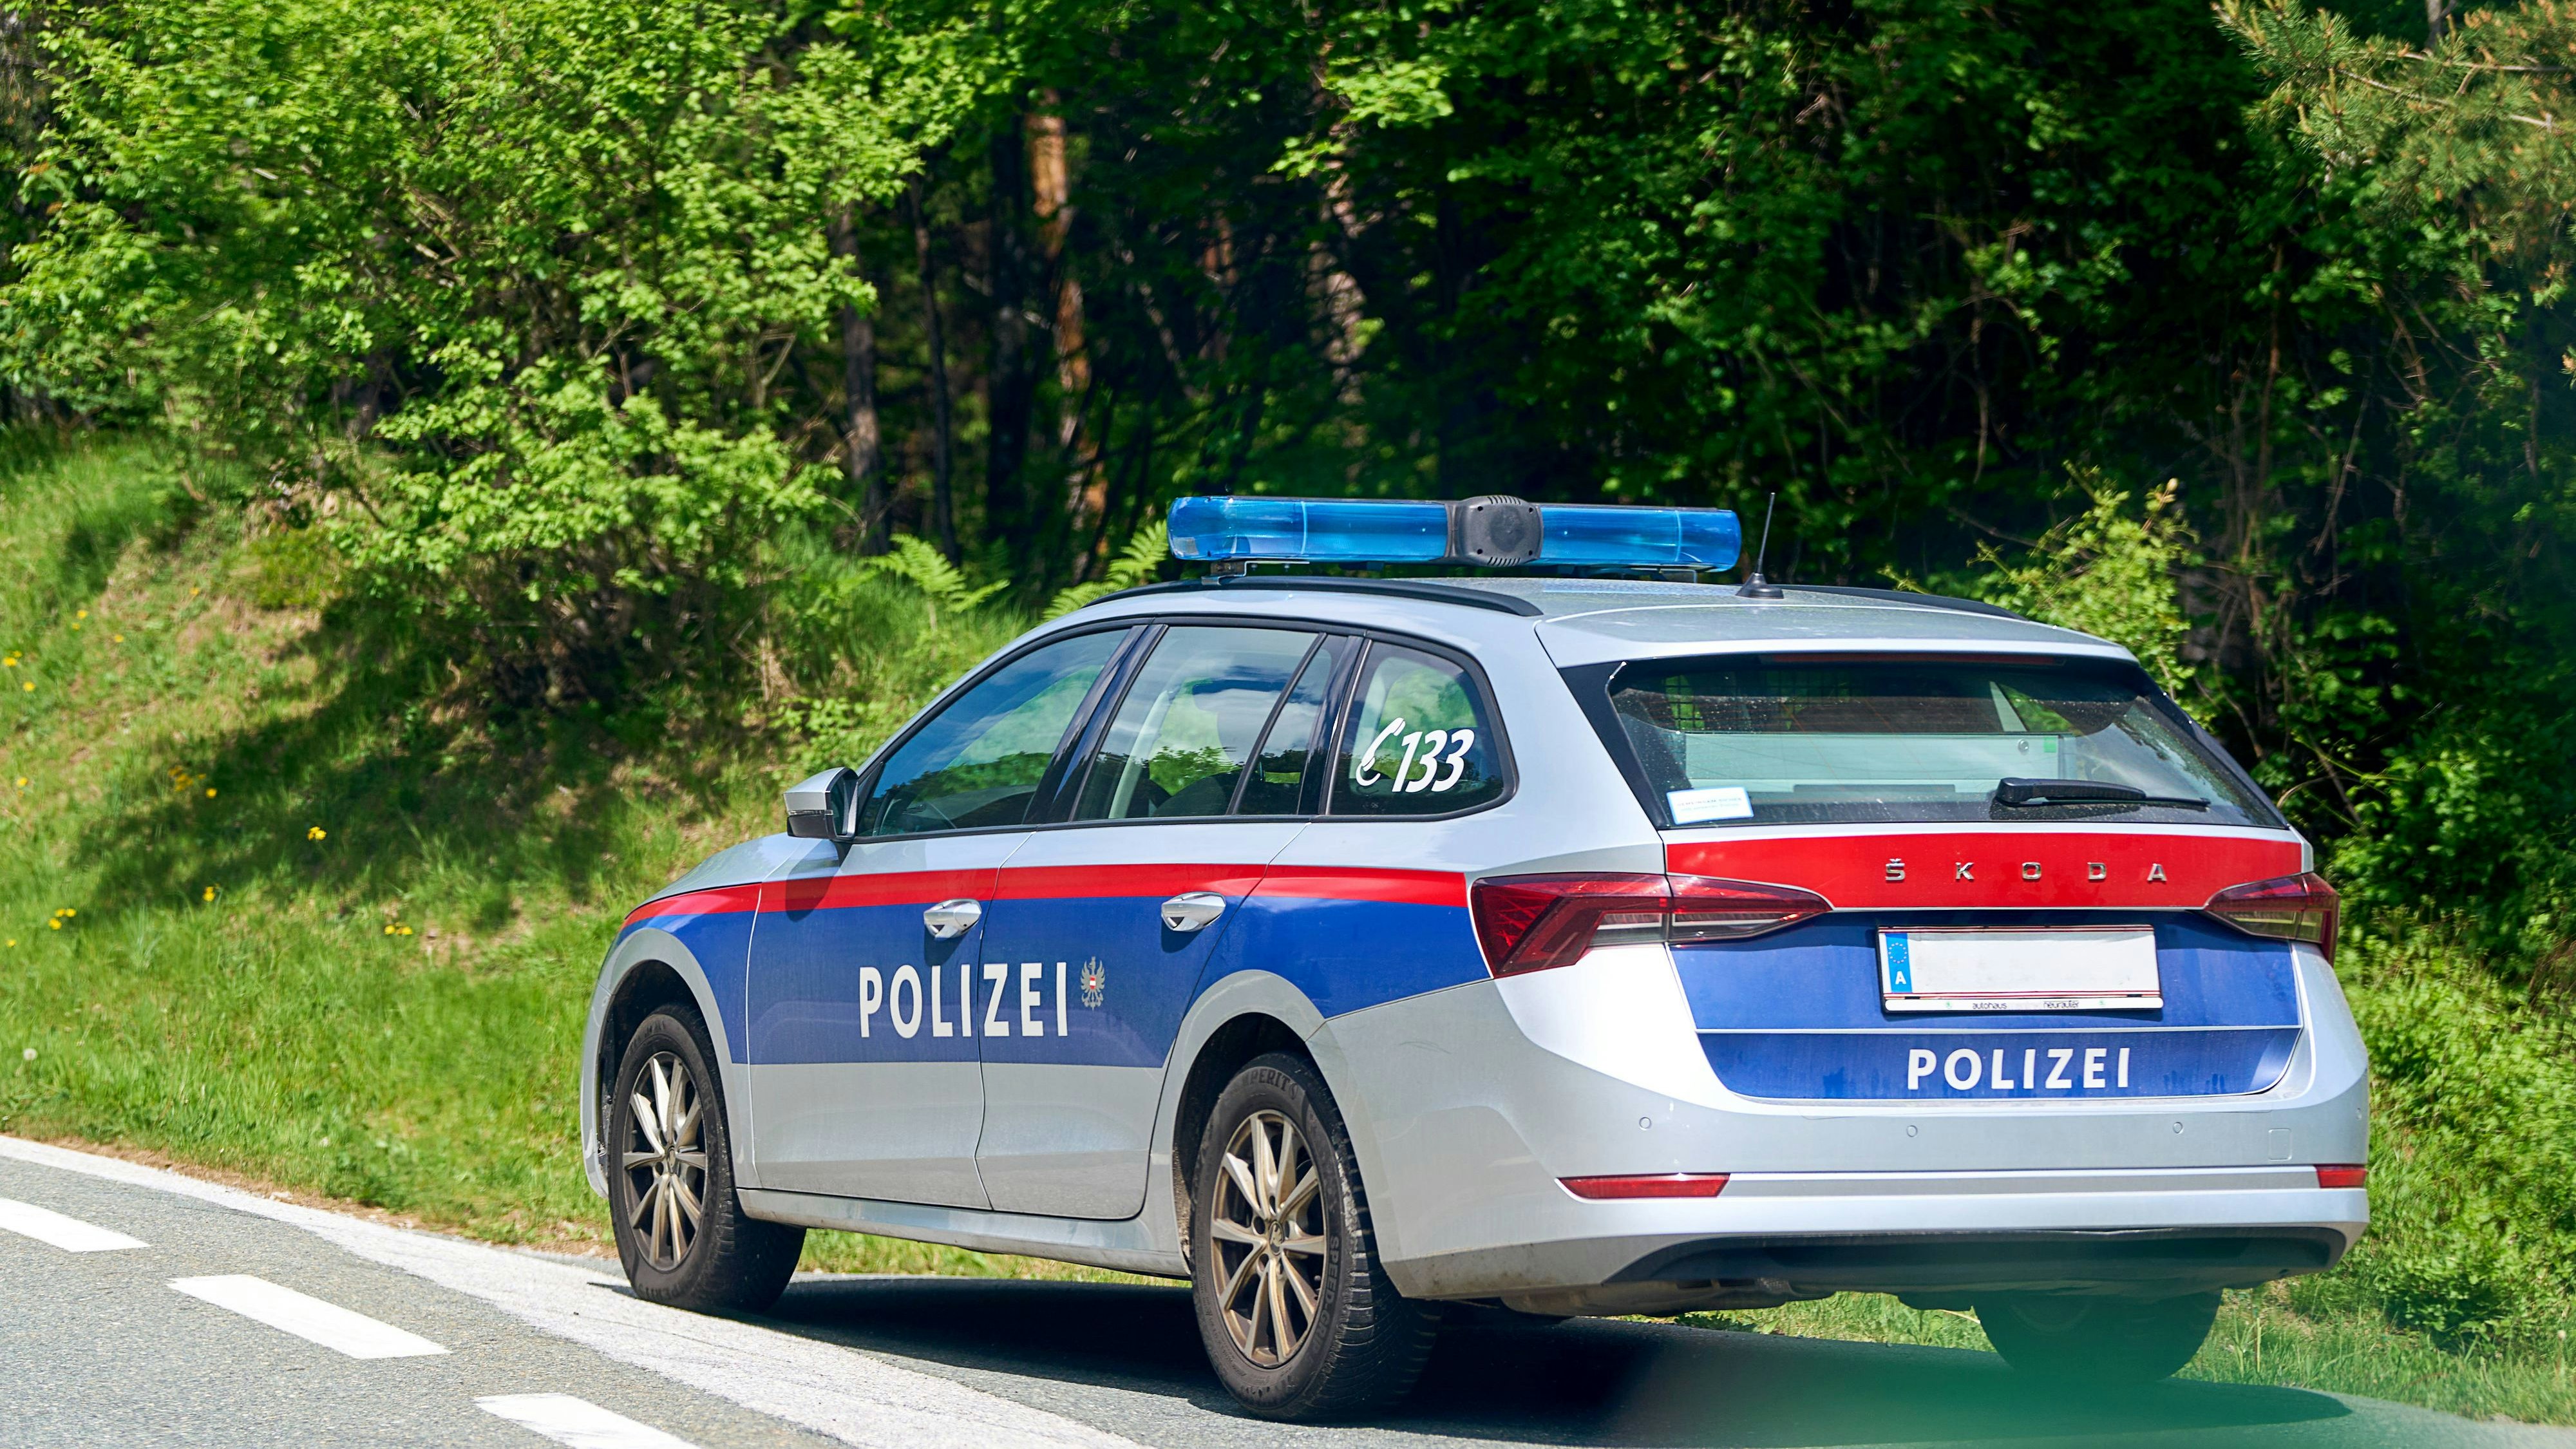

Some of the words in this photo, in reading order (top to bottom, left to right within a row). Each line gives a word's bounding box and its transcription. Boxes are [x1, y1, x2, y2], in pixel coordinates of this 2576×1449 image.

[1392, 729, 1475, 793] 133
[1885, 858, 2167, 882] ŠKODA
[1895, 971, 1907, 985] A
[859, 961, 1068, 1039] POLIZEI
[1908, 1047, 2130, 1090] POLIZEI
